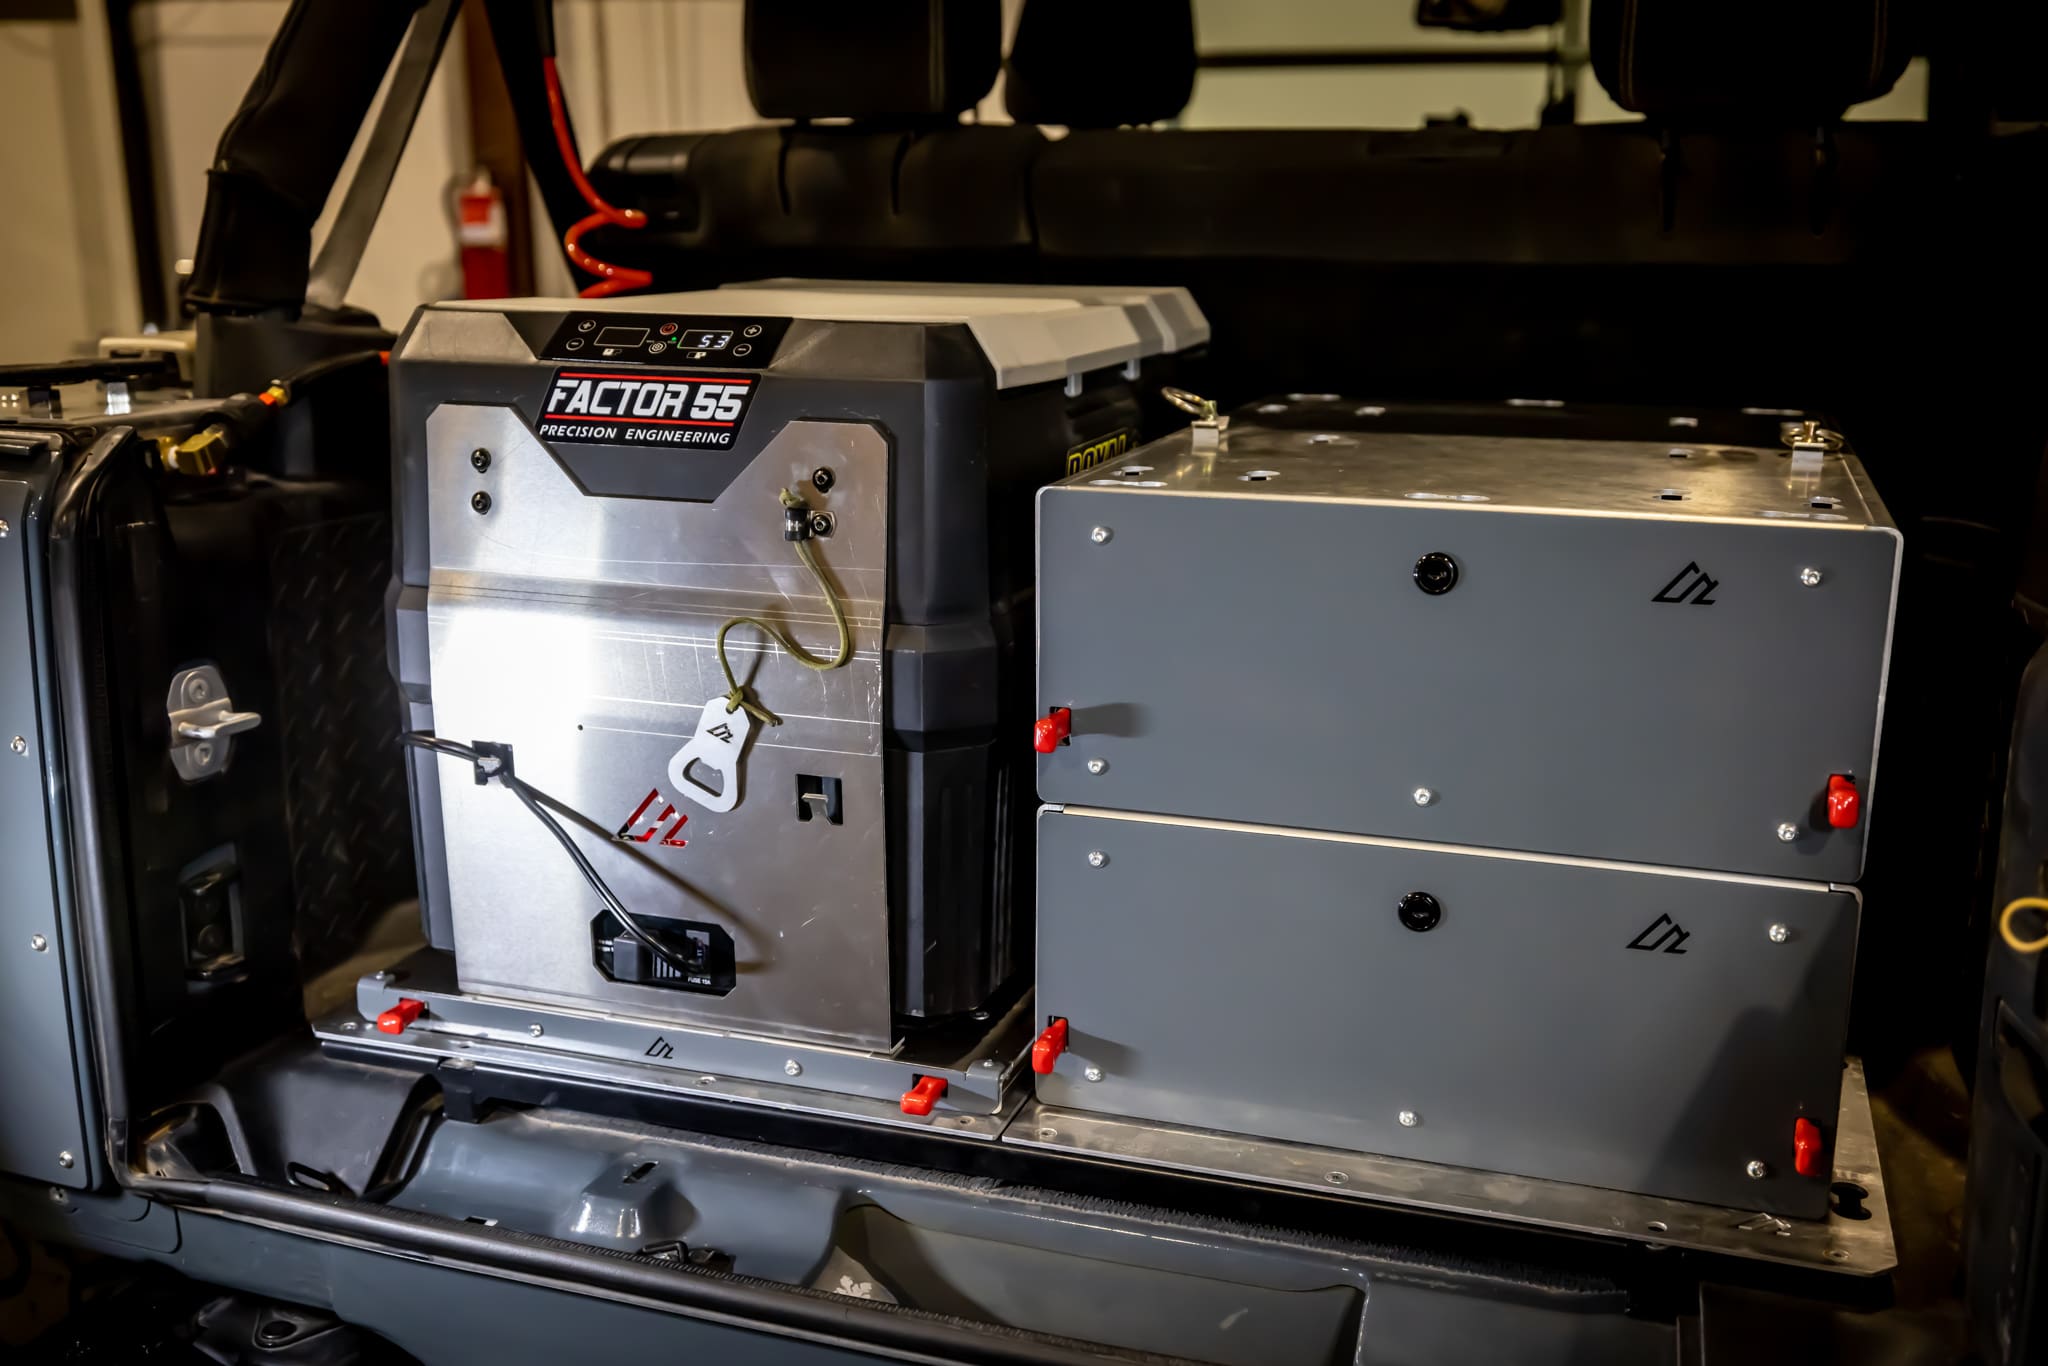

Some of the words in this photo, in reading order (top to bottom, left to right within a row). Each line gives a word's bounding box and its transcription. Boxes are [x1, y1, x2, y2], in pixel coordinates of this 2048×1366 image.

[698, 333, 730, 348] 53
[548, 380, 689, 418] FACTOR
[690, 385, 749, 420] 55
[539, 425, 617, 438] PRECISION
[624, 429, 730, 445] ENGINEERING
